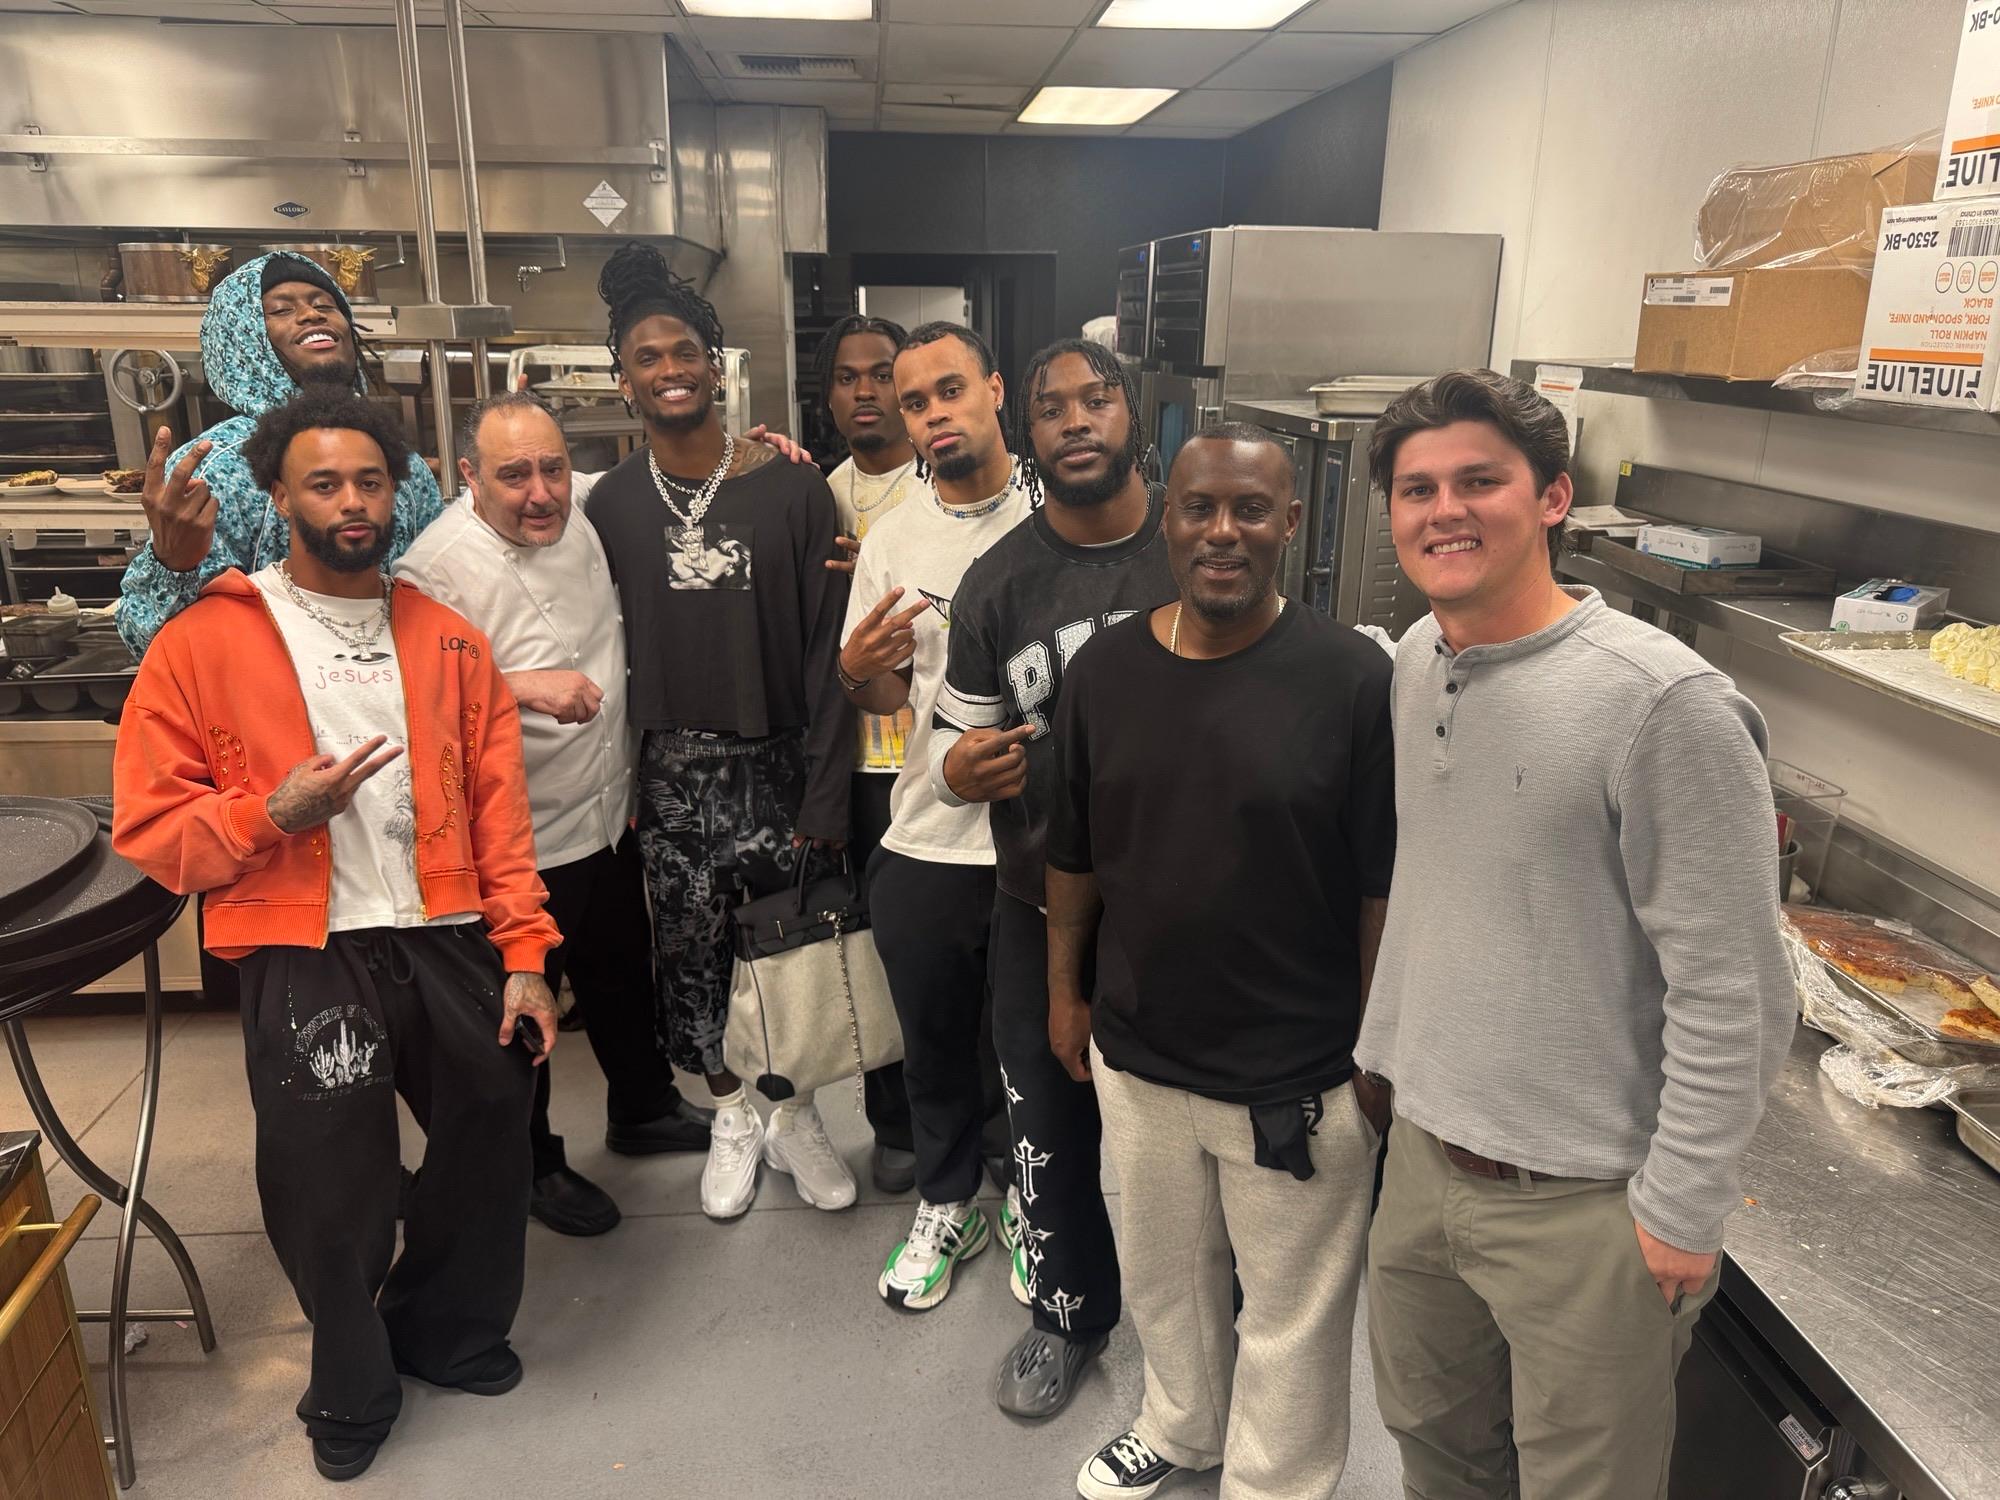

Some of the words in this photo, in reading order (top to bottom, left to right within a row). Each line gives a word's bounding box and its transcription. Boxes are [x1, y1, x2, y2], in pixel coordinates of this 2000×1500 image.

[1883, 231, 1939, 251] 2530-BK
[1963, 298, 1994, 308] BLACK
[1888, 312, 1912, 324] KNIFE,
[1965, 313, 1991, 325] FORK,
[1930, 329, 1952, 339] ROLL
[1954, 330, 1988, 340] NAPKIN
[1865, 363, 1982, 399] FINELINE
